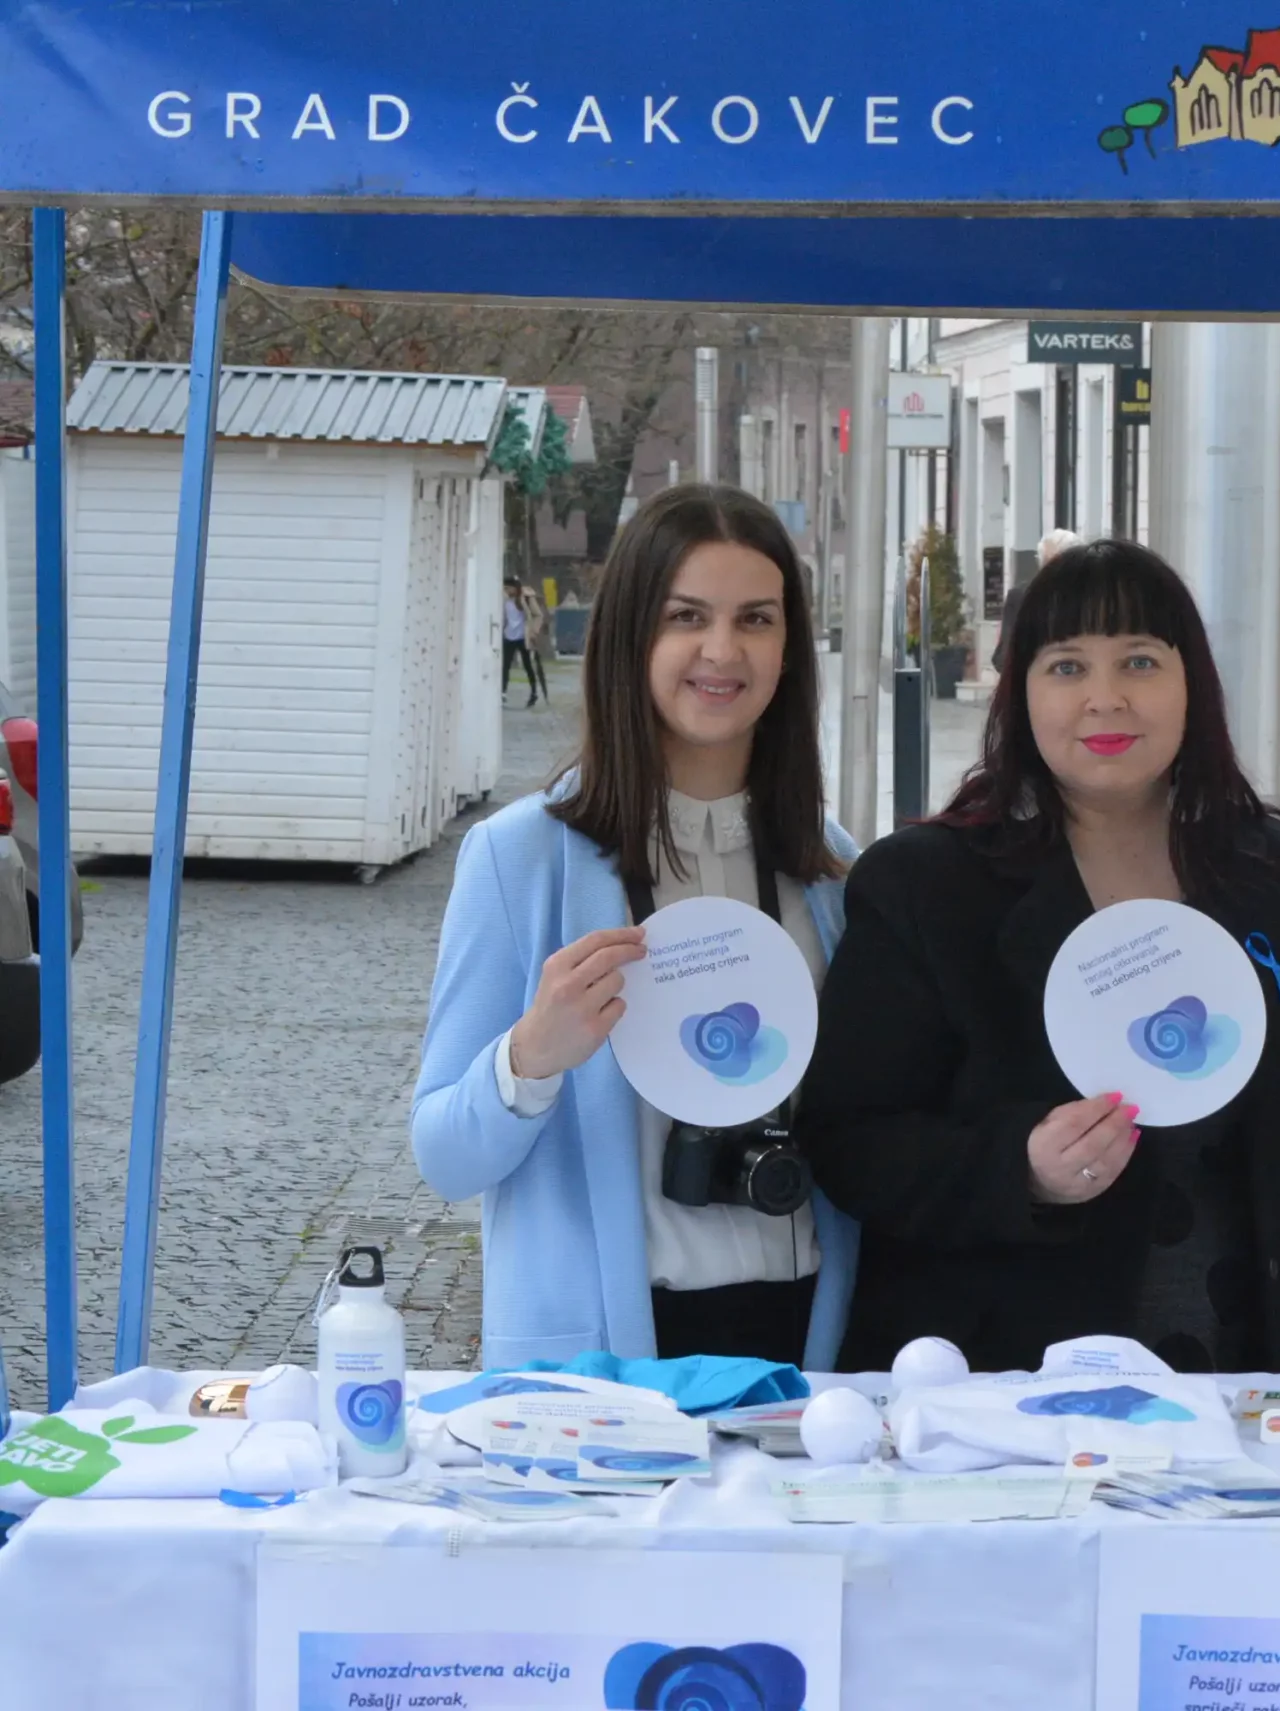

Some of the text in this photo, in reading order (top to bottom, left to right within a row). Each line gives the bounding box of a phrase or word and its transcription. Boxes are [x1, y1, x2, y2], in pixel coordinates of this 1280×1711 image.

[147, 81, 974, 145] GRAD ČAKOVEC
[649, 927, 744, 957] Nacionalni program
[1129, 924, 1170, 949] program
[654, 954, 750, 985] raka debelog crijeva
[1090, 948, 1182, 999] raka debelog crijeva
[764, 1128, 789, 1137] Canon
[331, 1661, 571, 1683] Javnozdravstvena akcija
[1188, 1674, 1242, 1695] Pošalji
[348, 1692, 468, 1711] Pošalji uzorak,
